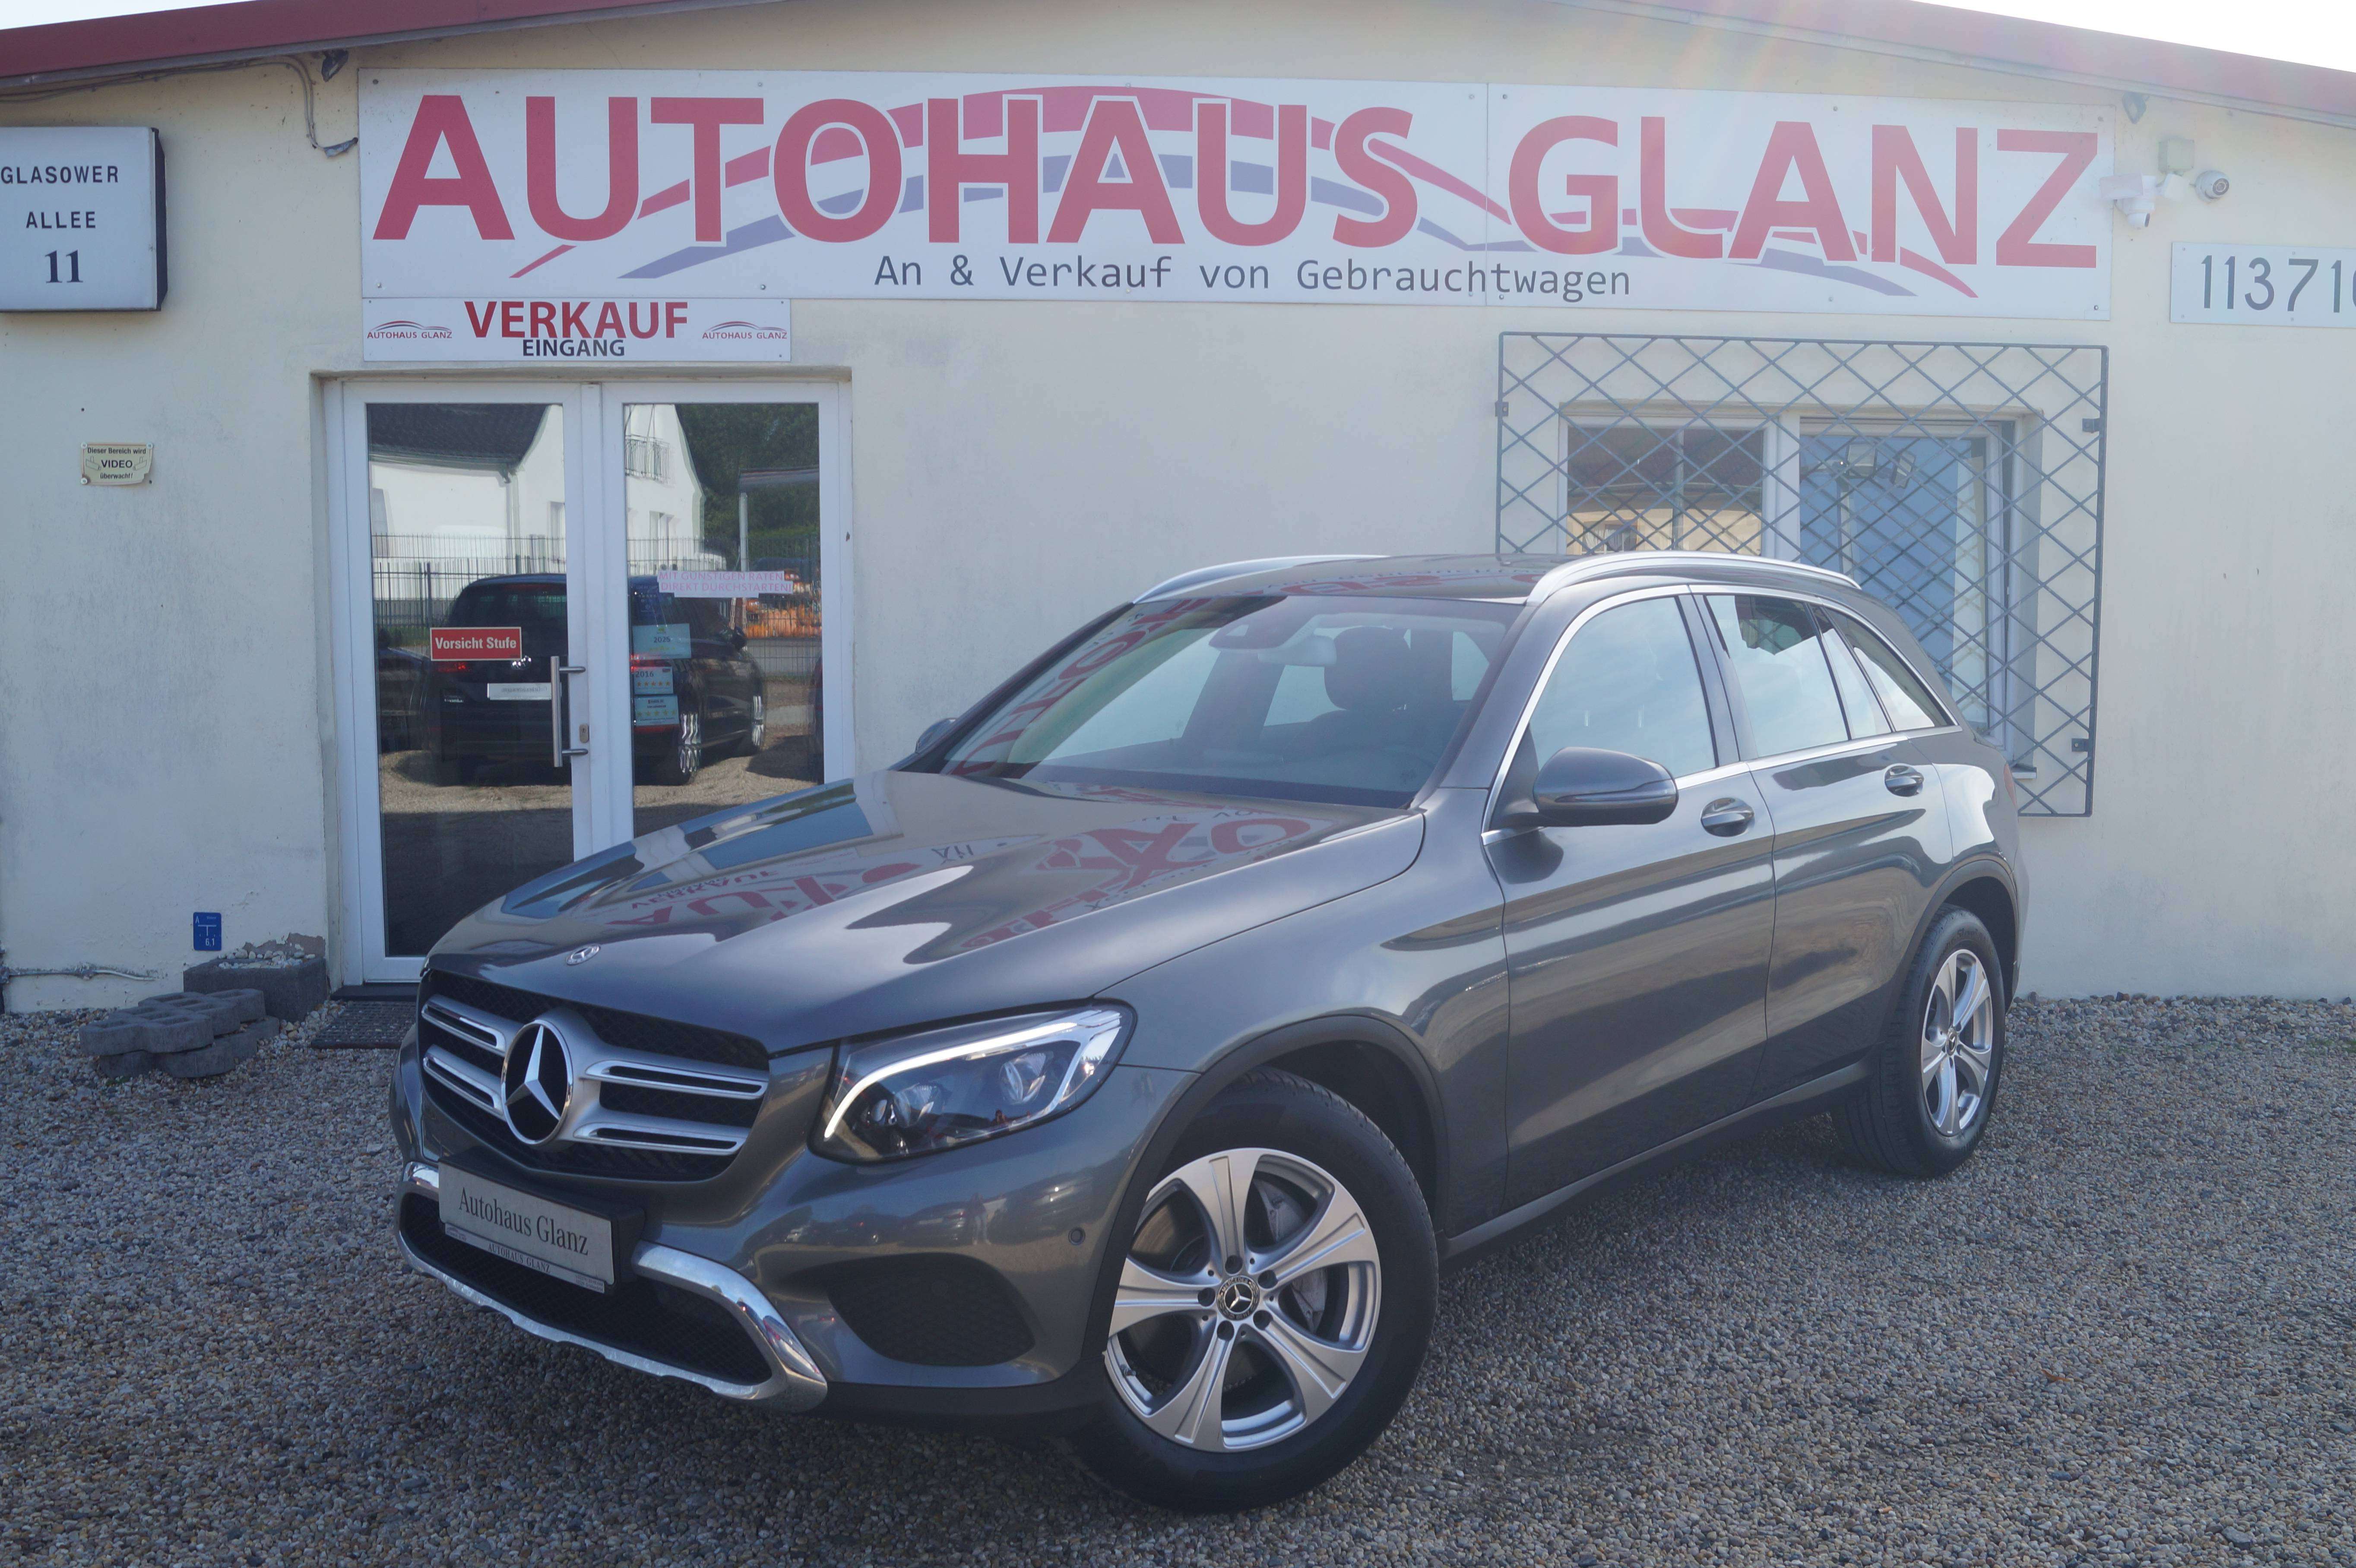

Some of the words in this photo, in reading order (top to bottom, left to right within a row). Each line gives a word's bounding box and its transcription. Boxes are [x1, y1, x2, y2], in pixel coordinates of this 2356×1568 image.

[1, 166, 118, 183] GLASOWER
[373, 95, 1418, 249] AUTOHAUS
[1509, 115, 2099, 268] GLANZ
[26, 211, 96, 229] ALLEE
[44, 249, 84, 284] 11
[874, 255, 922, 286] An
[950, 254, 975, 286] &
[999, 255, 1172, 288] Verkauf
[1199, 264, 1269, 289] von
[1296, 258, 1631, 302] Gebrauchtwagen
[2201, 255, 2356, 313] 11371
[464, 301, 688, 339] VERKAUF
[522, 339, 625, 357] EINGANG
[101, 460, 133, 468] VIDEO
[659, 572, 678, 581] MIT
[661, 582, 699, 591] DIREKT
[435, 637, 484, 649] Vorsicht
[486, 637, 517, 648] Stufe
[459, 1187, 532, 1237] Autohaus
[536, 1215, 589, 1256] Glanz
[488, 1242, 523, 1264] AUTOHAUS
[526, 1256, 551, 1274] GLANZ
